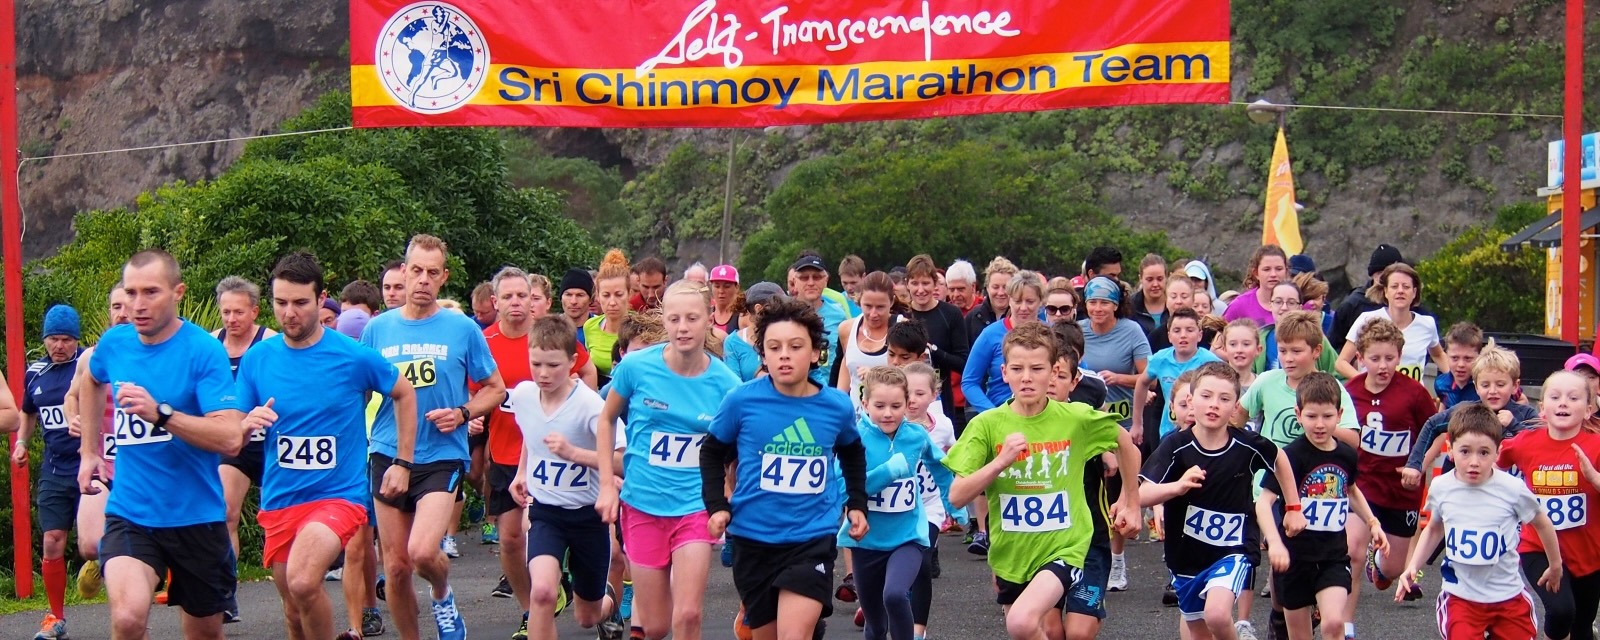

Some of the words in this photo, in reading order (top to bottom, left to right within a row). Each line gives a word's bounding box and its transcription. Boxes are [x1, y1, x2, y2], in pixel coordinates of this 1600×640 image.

[498, 66, 563, 102] Sri
[575, 72, 800, 110] Chinmoy
[816, 63, 1056, 101] Marathon
[1073, 52, 1210, 82] Team
[404, 360, 436, 385] 46
[279, 437, 334, 465] 248
[650, 434, 706, 463] 47
[764, 441, 823, 456] adidas
[1362, 429, 1409, 453] 477
[532, 459, 588, 488] 472
[762, 457, 825, 488] 479
[1002, 493, 1068, 527] 484
[1303, 500, 1348, 527] 475
[1536, 495, 1585, 526] 88
[1185, 510, 1243, 542] 482
[1446, 527, 1499, 561] 450
